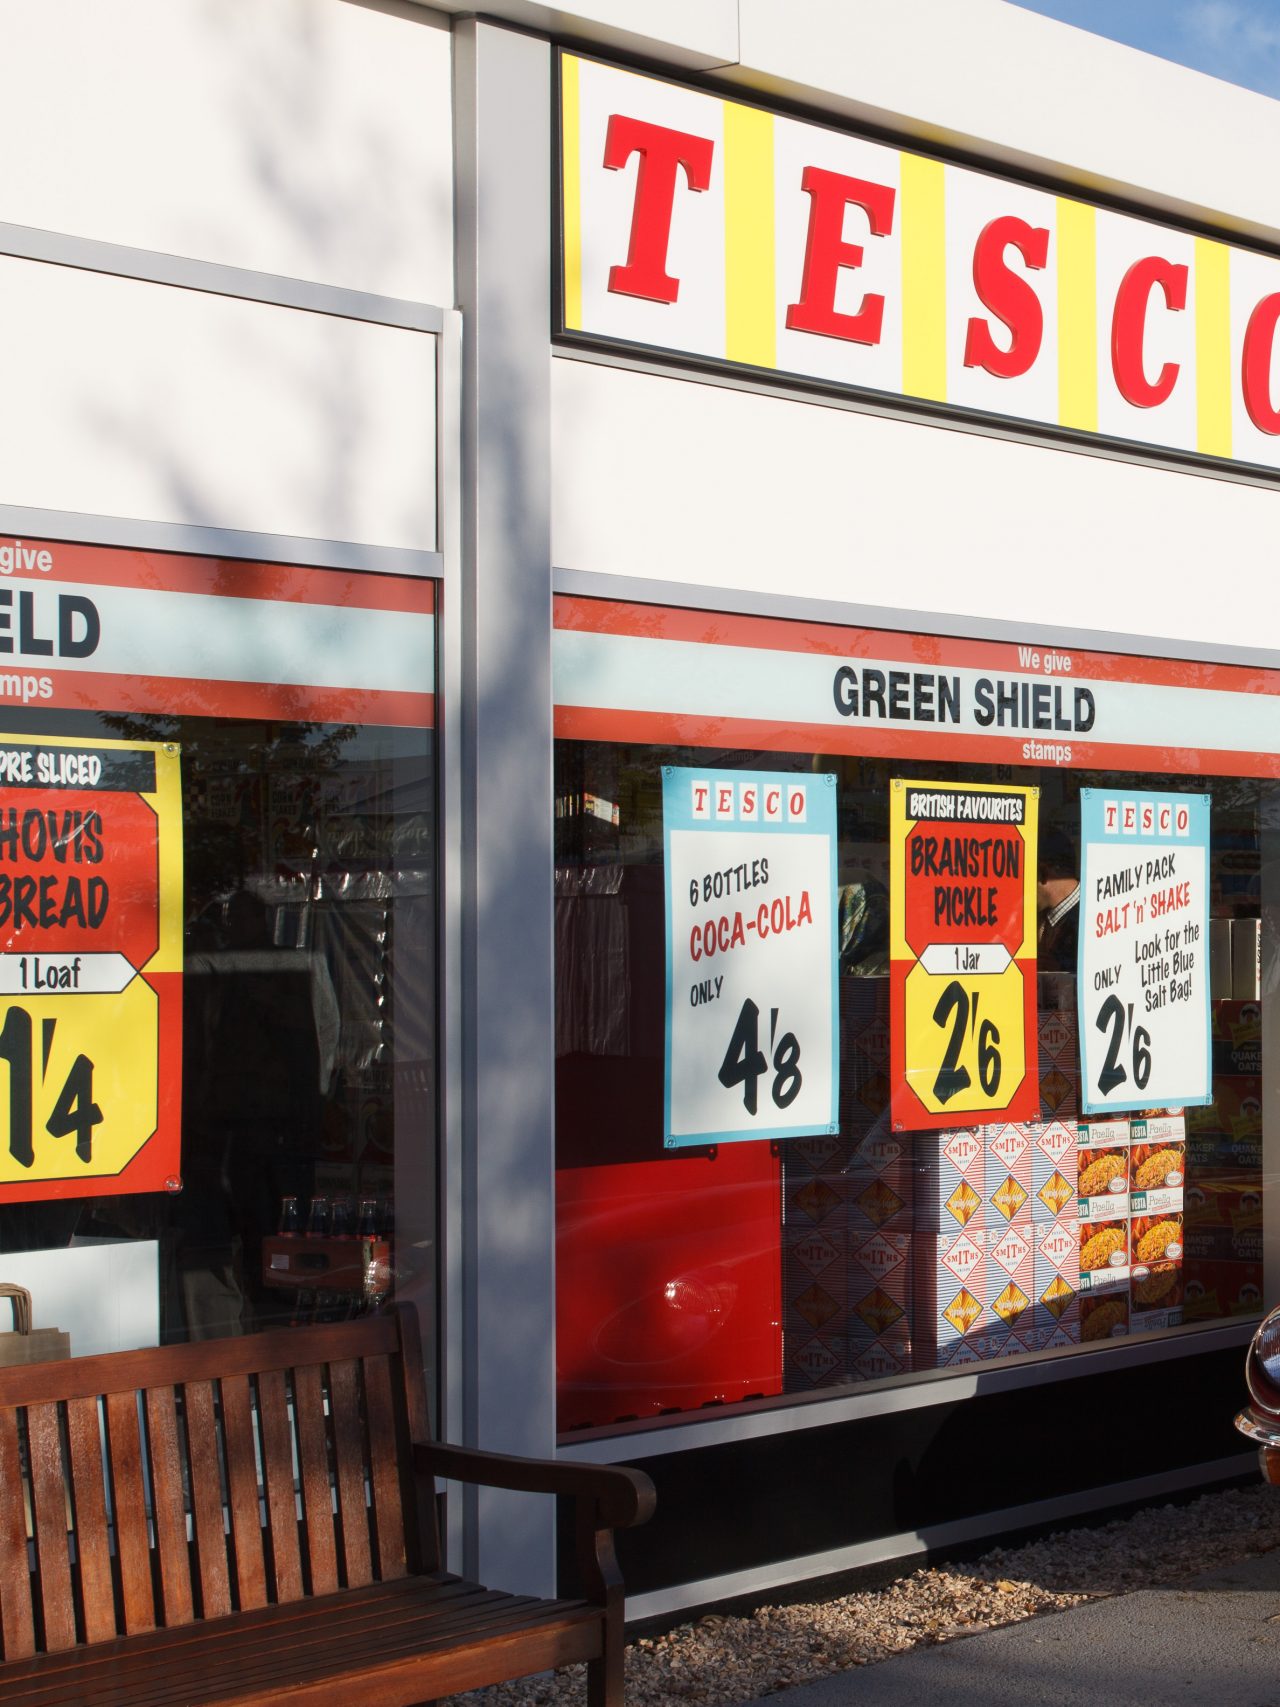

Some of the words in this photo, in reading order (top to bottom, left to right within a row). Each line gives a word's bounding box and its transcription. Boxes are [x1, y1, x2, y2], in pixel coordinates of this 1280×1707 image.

[0, 541, 53, 574] give
[1018, 646, 1040, 668] We
[1044, 648, 1072, 674] give
[833, 666, 960, 724] GREEN
[974, 678, 1096, 733] SHIELD
[1023, 740, 1072, 765] stamps
[37, 752, 102, 785] SLICED
[695, 788, 804, 815] TESCO
[910, 793, 955, 819] BRITISH
[957, 795, 1023, 821] FAVOURITES
[1106, 807, 1188, 830] TESCO
[0, 808, 104, 863] HOVIS
[911, 835, 1019, 879] BRANSTON
[689, 879, 699, 907] 6
[703, 858, 769, 902] BOTTLES
[1096, 864, 1143, 902] FAMILY
[1146, 853, 1175, 884] PACK
[934, 886, 998, 927] PICKLE
[1096, 903, 1130, 938] SALT
[1151, 881, 1190, 918] SHAKE
[690, 891, 813, 961] COCA-COLA
[1135, 933, 1161, 963] Look
[1165, 929, 1180, 952] for
[1184, 920, 1200, 945] the
[954, 947, 959, 970] 1
[962, 947, 980, 970] Jar
[1141, 958, 1170, 987] Little
[1173, 951, 1194, 975] Blue
[20, 957, 27, 989] 1
[35, 957, 81, 989] Loaf
[1094, 964, 1121, 991] ONLY
[690, 975, 724, 1007] ONLY
[1145, 985, 1166, 1012] Salt
[1170, 973, 1192, 1002] Bag!
[1231, 1052, 1262, 1063] QUAKE
[1041, 1134, 1070, 1148] SMITHS
[1092, 1128, 1115, 1139] Paella
[1131, 1126, 1146, 1138] VESTA
[1149, 1122, 1172, 1134] Paella
[949, 1142, 977, 1157] SMITHS
[995, 1138, 1025, 1153] SMITHS
[1231, 1144, 1263, 1155] QUAKE
[1091, 1201, 1115, 1212] Paella
[1131, 1196, 1146, 1211] VESTA
[1149, 1194, 1171, 1206] Paella
[996, 1243, 1026, 1258] SMITHS
[1043, 1238, 1073, 1252] SMITHS
[1231, 1236, 1263, 1247] QUAKE
[858, 1250, 898, 1264] SMITHS
[947, 1249, 979, 1265] SMITHS
